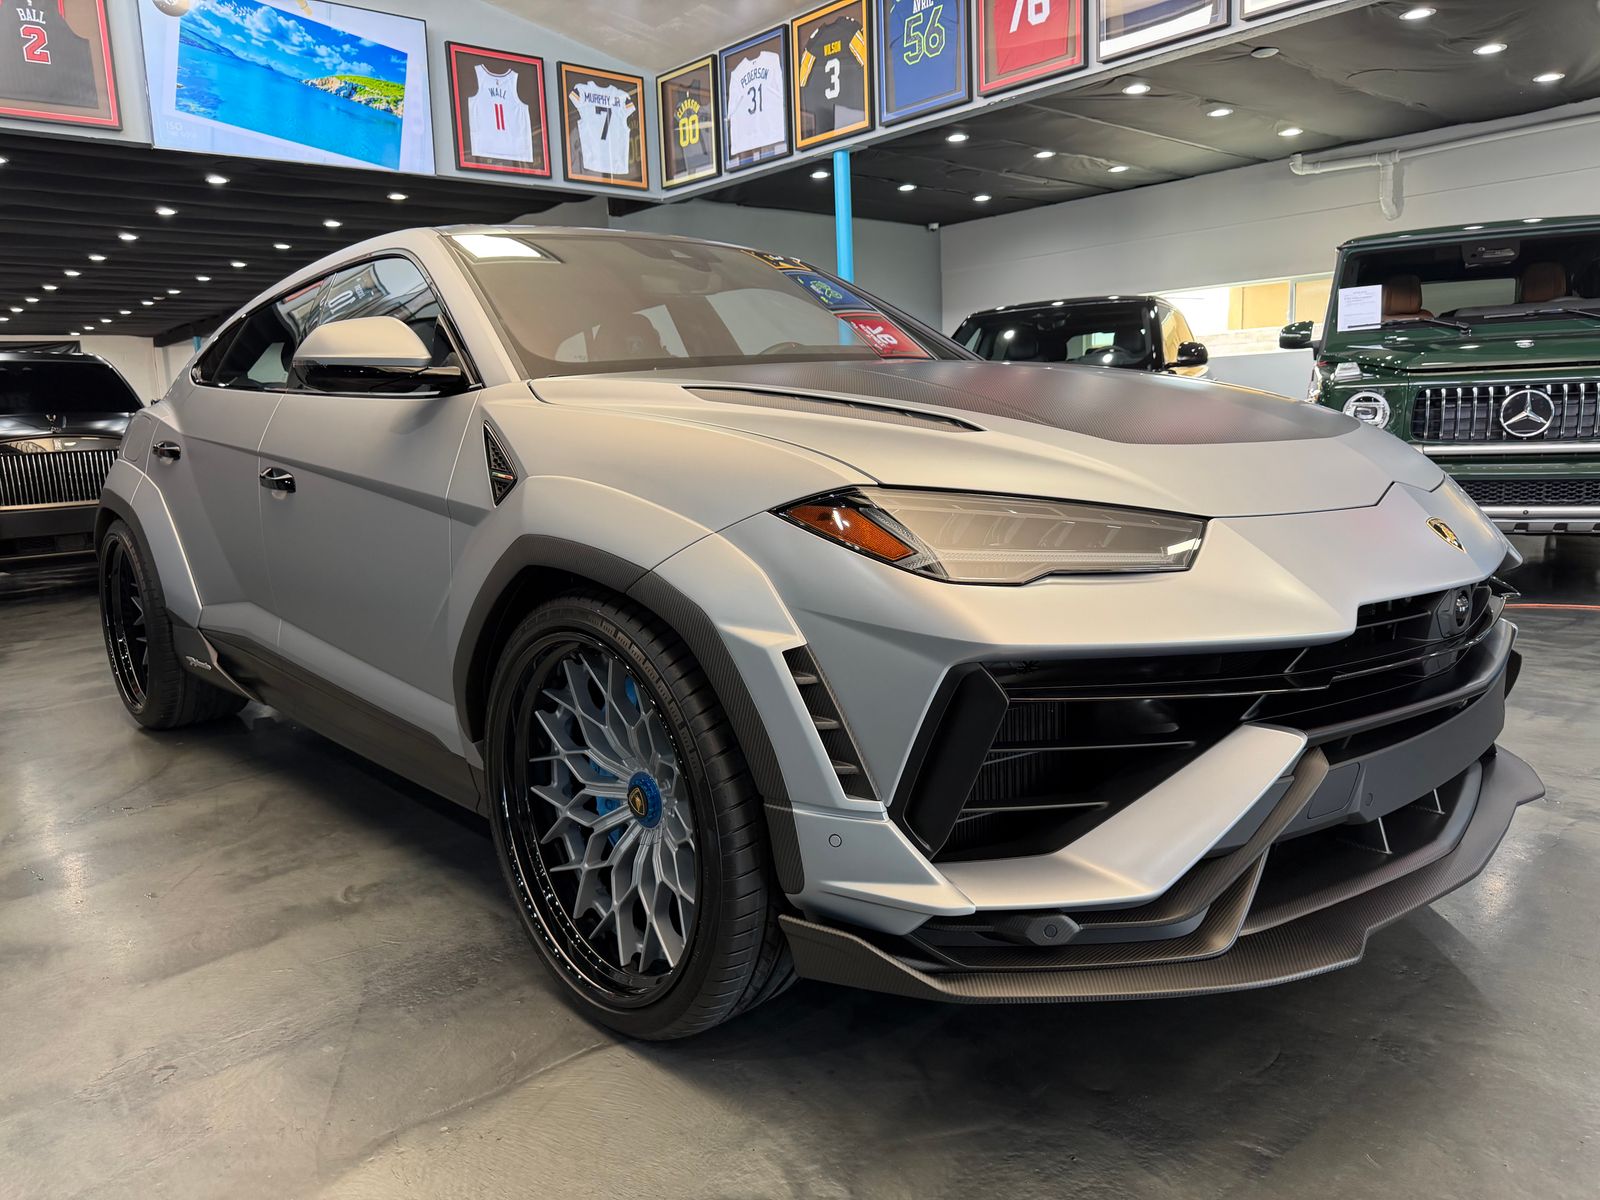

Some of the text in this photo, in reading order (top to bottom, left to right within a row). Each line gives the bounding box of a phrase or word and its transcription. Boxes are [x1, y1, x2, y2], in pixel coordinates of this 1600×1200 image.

[16, 8, 46, 24] BALL
[20, 24, 51, 64] 2
[904, 4, 944, 65] 56
[488, 88, 506, 99] WALL
[825, 58, 840, 99] 3
[584, 92, 621, 107] MURPHY JR
[748, 83, 762, 115] 31
[494, 103, 505, 131] 11
[595, 106, 612, 140] 7
[679, 114, 699, 147] 00
